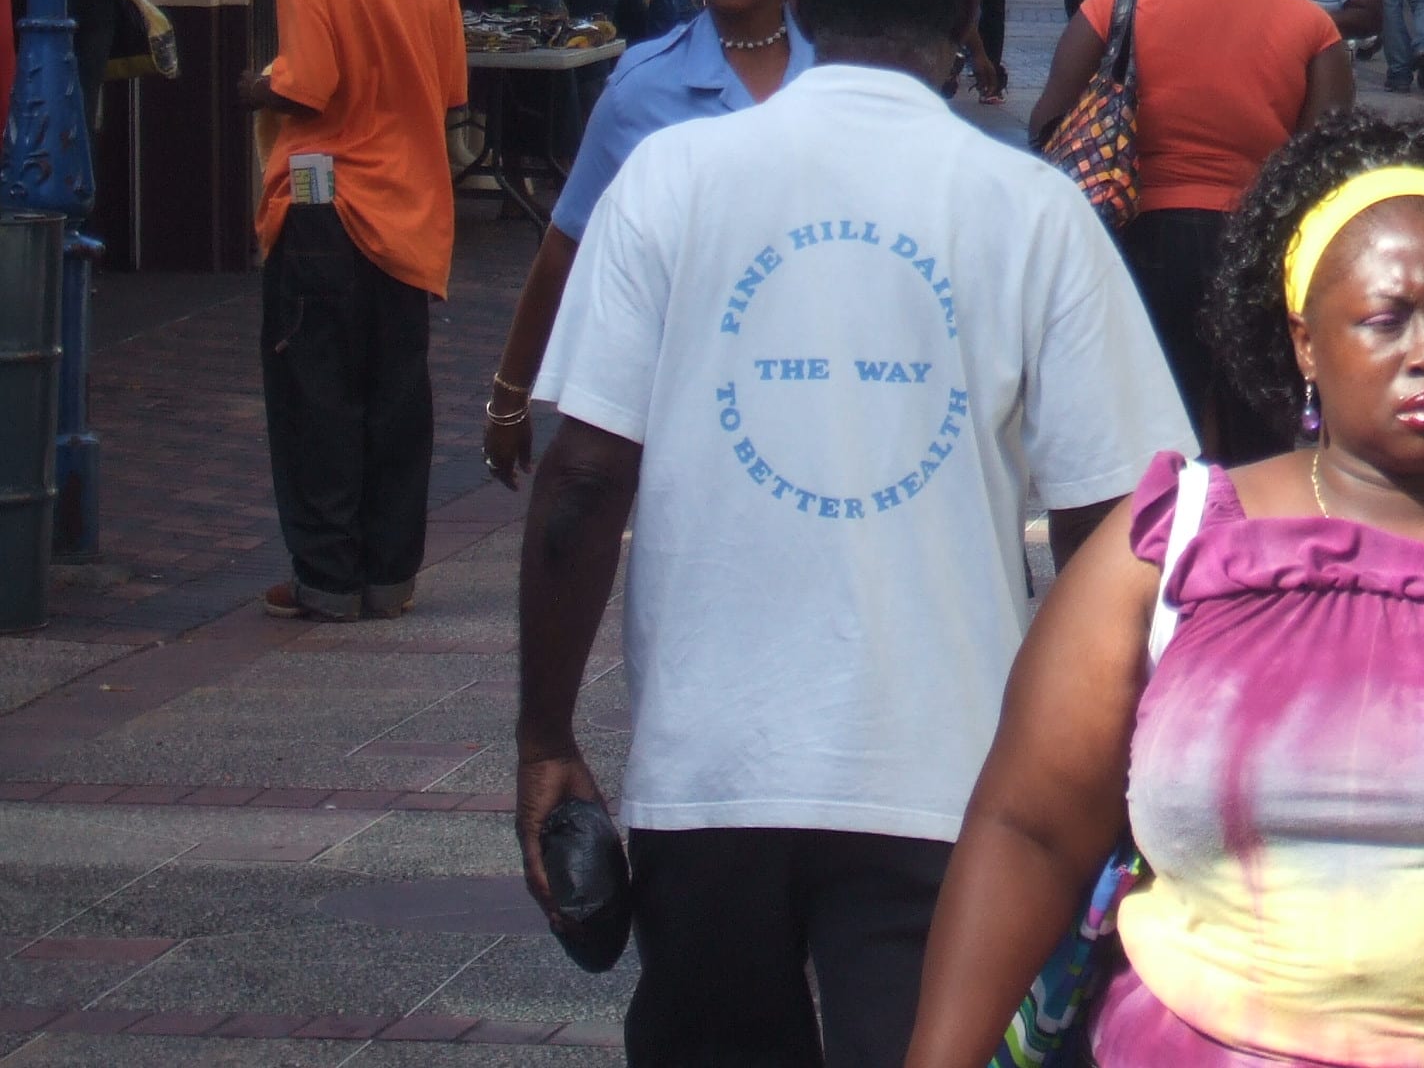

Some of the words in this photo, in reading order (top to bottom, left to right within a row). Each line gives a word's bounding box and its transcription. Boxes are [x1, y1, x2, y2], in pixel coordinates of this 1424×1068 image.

[719, 245, 783, 335] PINE
[788, 220, 881, 251] HILL
[754, 359, 830, 380] THE
[854, 360, 932, 383] WAY
[716, 381, 741, 433] TO
[733, 436, 866, 519] BETTER
[871, 387, 968, 513] HEALTH
